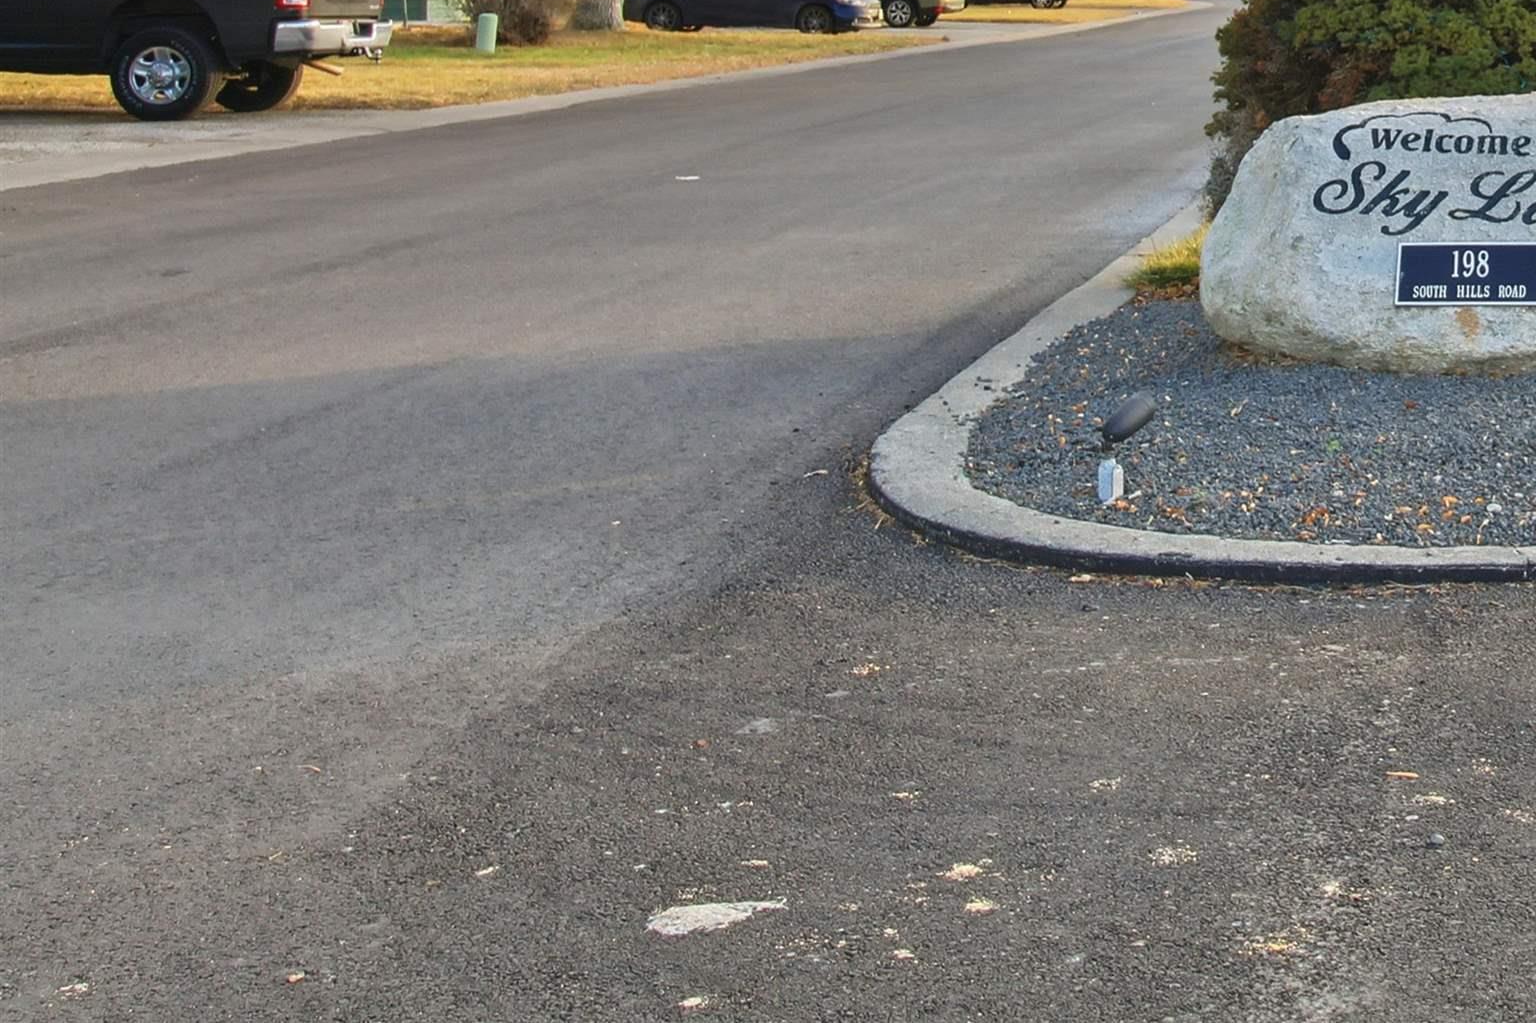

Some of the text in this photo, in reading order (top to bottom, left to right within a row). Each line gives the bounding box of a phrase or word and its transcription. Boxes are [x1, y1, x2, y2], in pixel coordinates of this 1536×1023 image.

[1370, 127, 1532, 157] Welcome
[1312, 160, 1449, 236] Sky
[1450, 249, 1490, 278] 198
[1411, 284, 1527, 298] SOUTH HILLS ROAD
